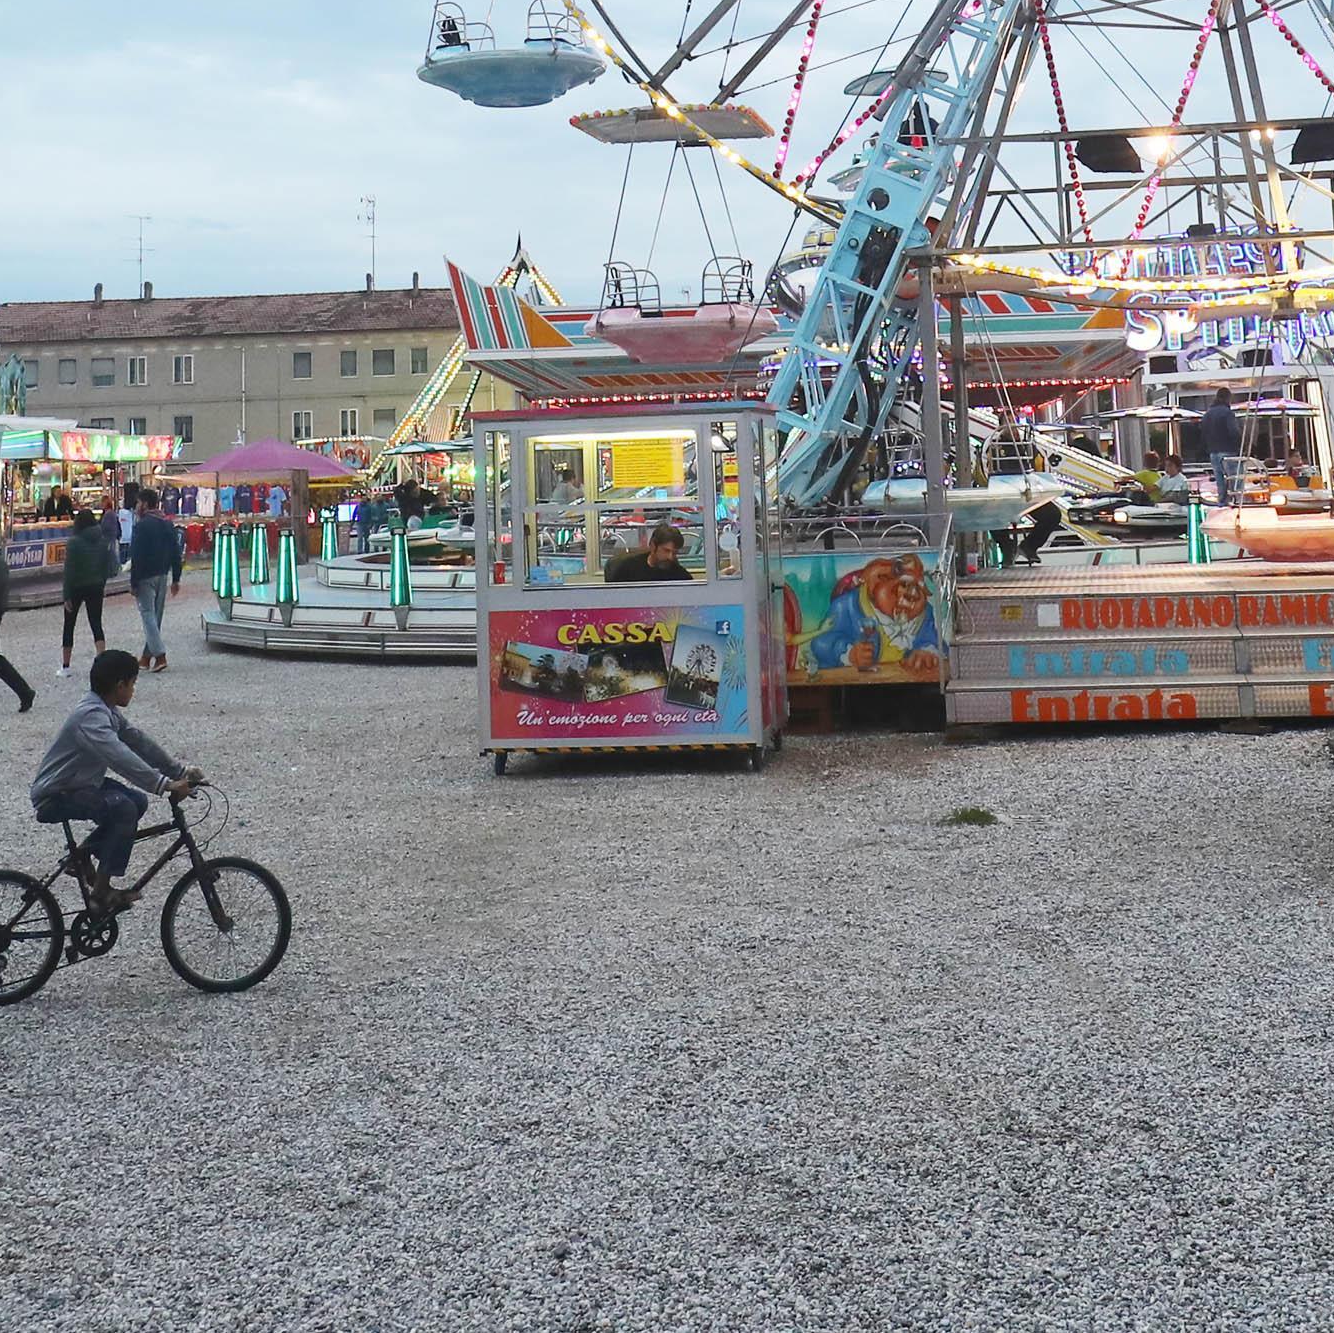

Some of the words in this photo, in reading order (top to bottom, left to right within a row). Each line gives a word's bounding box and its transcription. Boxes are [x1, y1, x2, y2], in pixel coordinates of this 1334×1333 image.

[557, 622, 674, 646] CASSA
[1008, 644, 1189, 678] Entrata
[622, 711, 649, 728] per
[654, 711, 688, 728] ogni
[1011, 688, 1197, 722] Entrata
